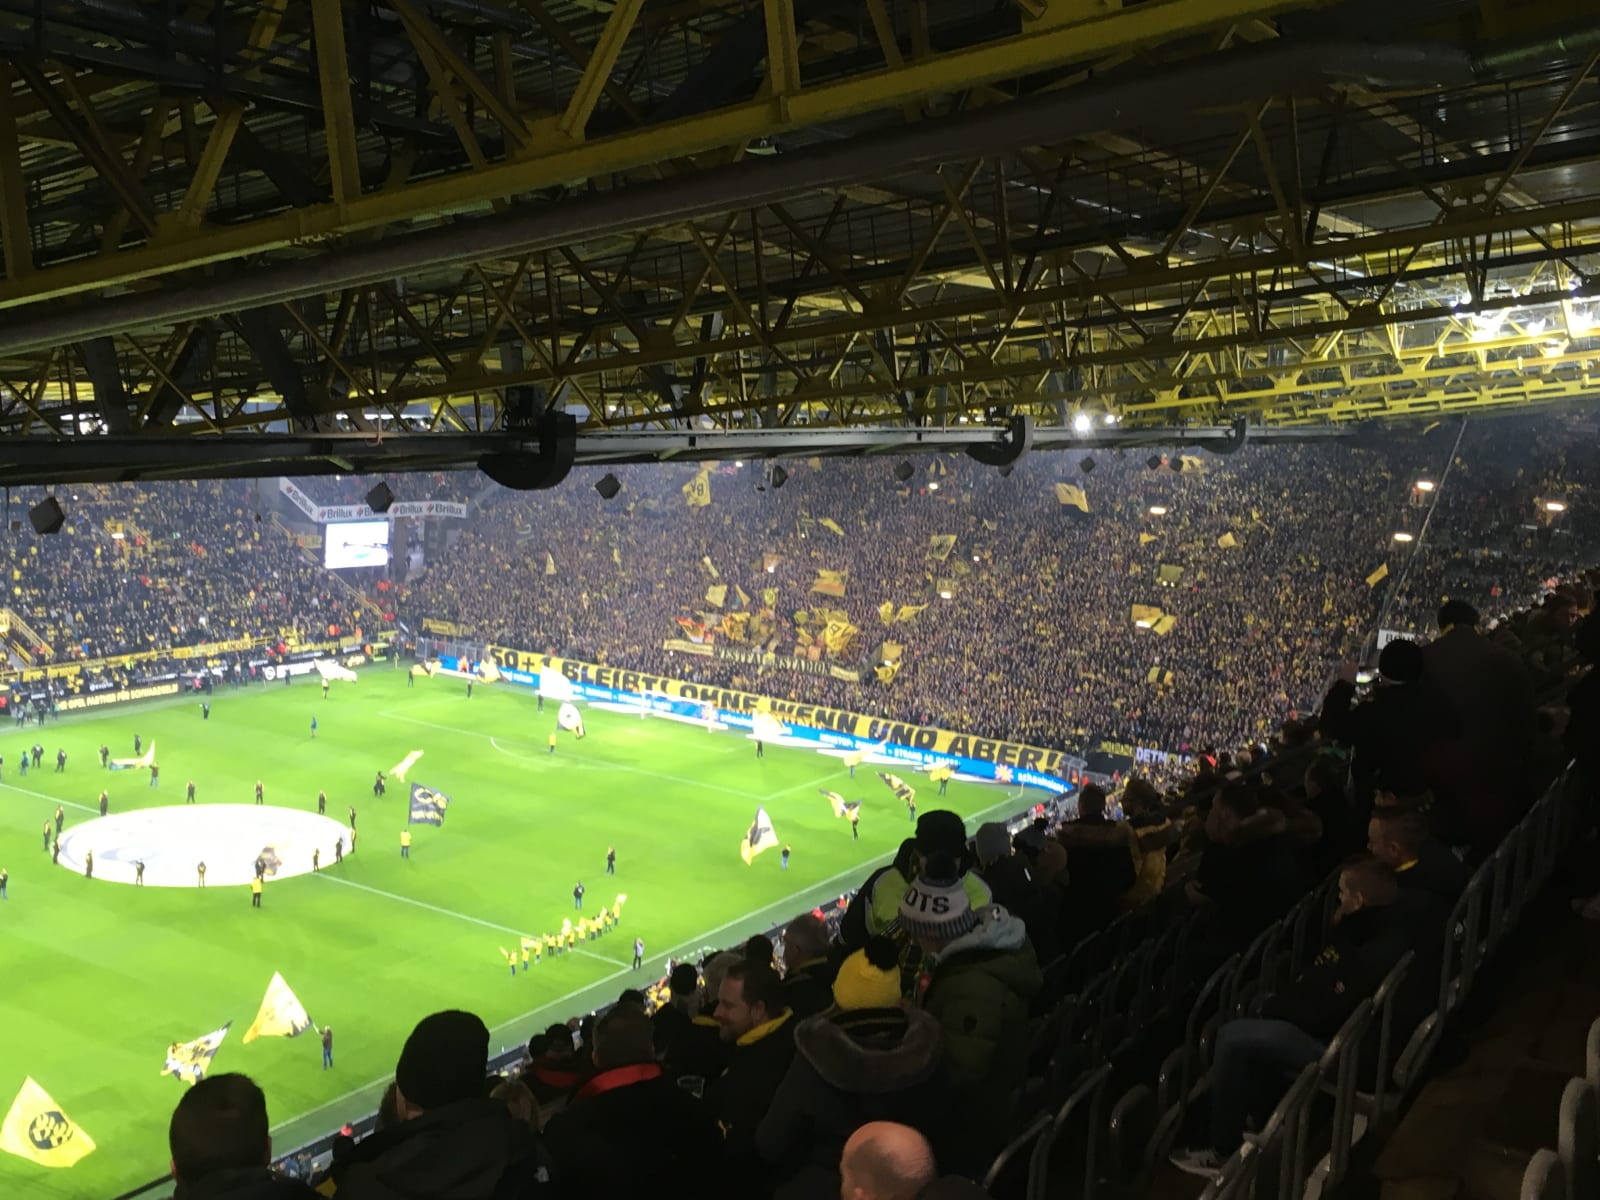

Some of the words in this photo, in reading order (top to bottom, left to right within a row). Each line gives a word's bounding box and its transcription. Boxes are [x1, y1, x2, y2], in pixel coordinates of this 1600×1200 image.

[292, 488, 314, 514] Brillux
[327, 507, 353, 519] Brillux
[400, 503, 423, 514] Brillux
[435, 503, 464, 514] Brillux
[680, 684, 760, 711] OHNE
[868, 720, 938, 750] UND
[947, 736, 1060, 777] ABER!
